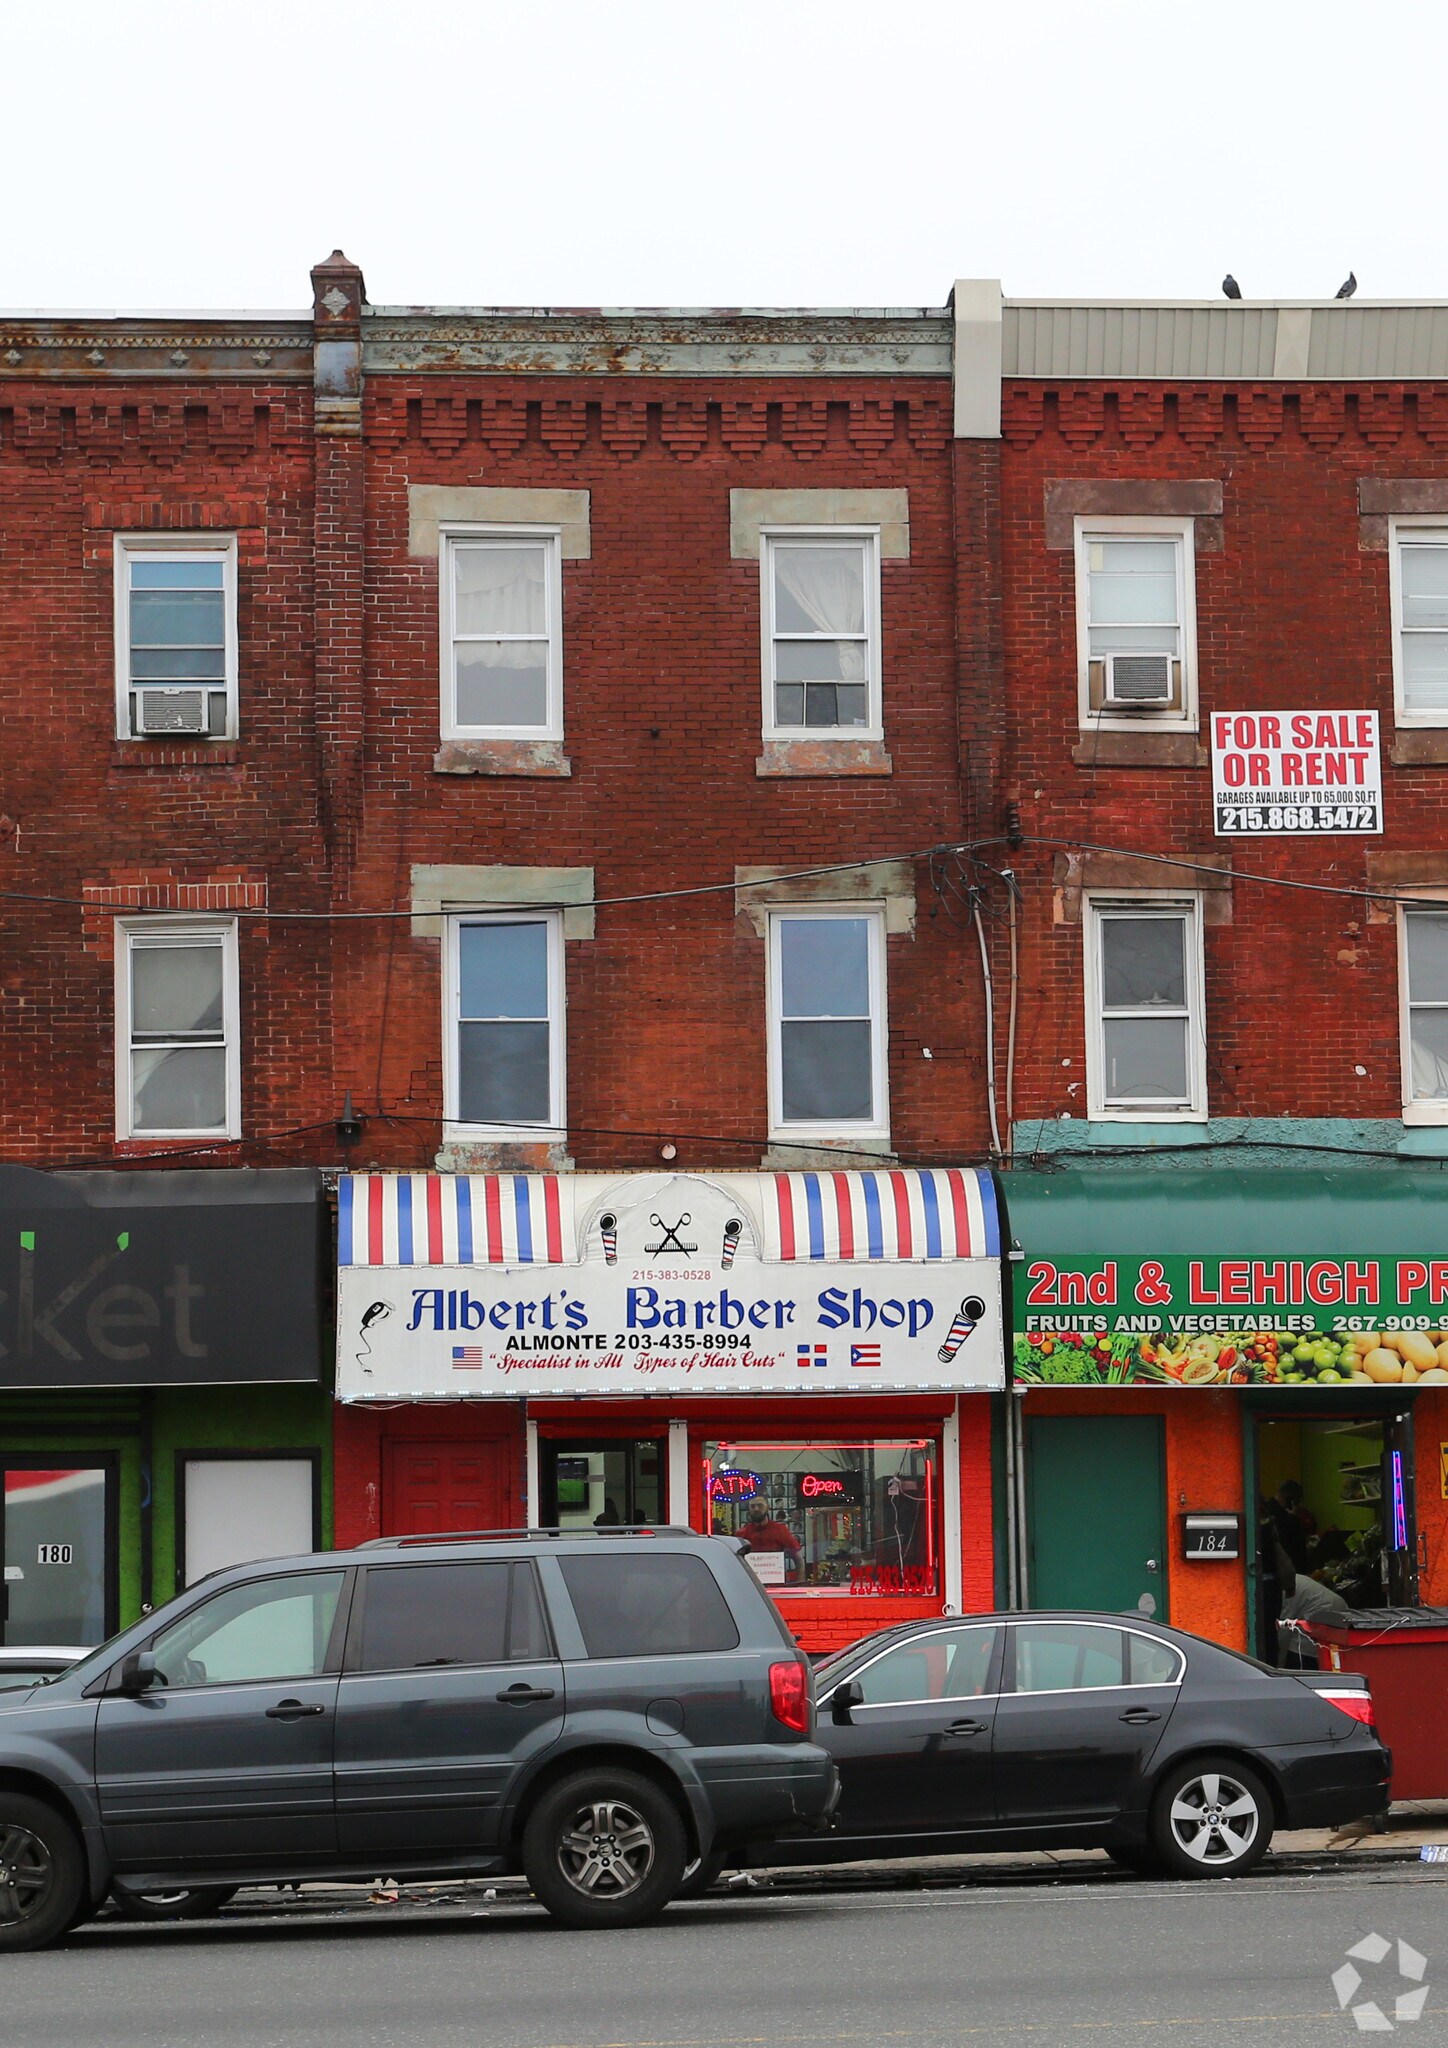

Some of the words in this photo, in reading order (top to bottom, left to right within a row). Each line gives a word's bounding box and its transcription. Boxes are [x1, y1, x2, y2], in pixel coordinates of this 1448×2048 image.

[1215, 716, 1281, 749] FOR
[1291, 715, 1374, 749] SALE
[1223, 753, 1271, 787] OR
[1281, 752, 1369, 786] RENT
[1217, 791, 1254, 804] GARAGES
[1255, 791, 1298, 804] AVAILABLE
[1299, 791, 1310, 804] UP
[1311, 791, 1322, 804] TO
[1324, 791, 1353, 804] 65,000
[1355, 790, 1377, 804] SQ.FT
[1222, 807, 1373, 830] 215.868.5472
[632, 1270, 711, 1281] 215-383-0528
[1026, 1261, 1118, 1306] 2nd
[1134, 1261, 1173, 1306] &
[1189, 1260, 1380, 1306] LEHIGH
[0, 1231, 208, 1361] ket
[406, 1289, 589, 1331] Albert's
[626, 1286, 797, 1329] Barber
[817, 1286, 934, 1338] Shop
[1026, 1315, 1107, 1332] FRUITS
[1114, 1315, 1162, 1332] AND
[1168, 1315, 1315, 1332] VEGETABLES
[505, 1334, 607, 1351] ALMONTE
[614, 1333, 751, 1350] 203-435-8994
[575, 1355, 590, 1369] in
[593, 1353, 623, 1369] All
[633, 1352, 678, 1373] Types
[680, 1352, 700, 1373] of
[698, 1351, 737, 1368] Hair
[712, 1476, 755, 1495] ATM
[802, 1475, 843, 1496] Open
[1198, 1536, 1227, 1551] 184
[40, 1546, 71, 1563] 180
